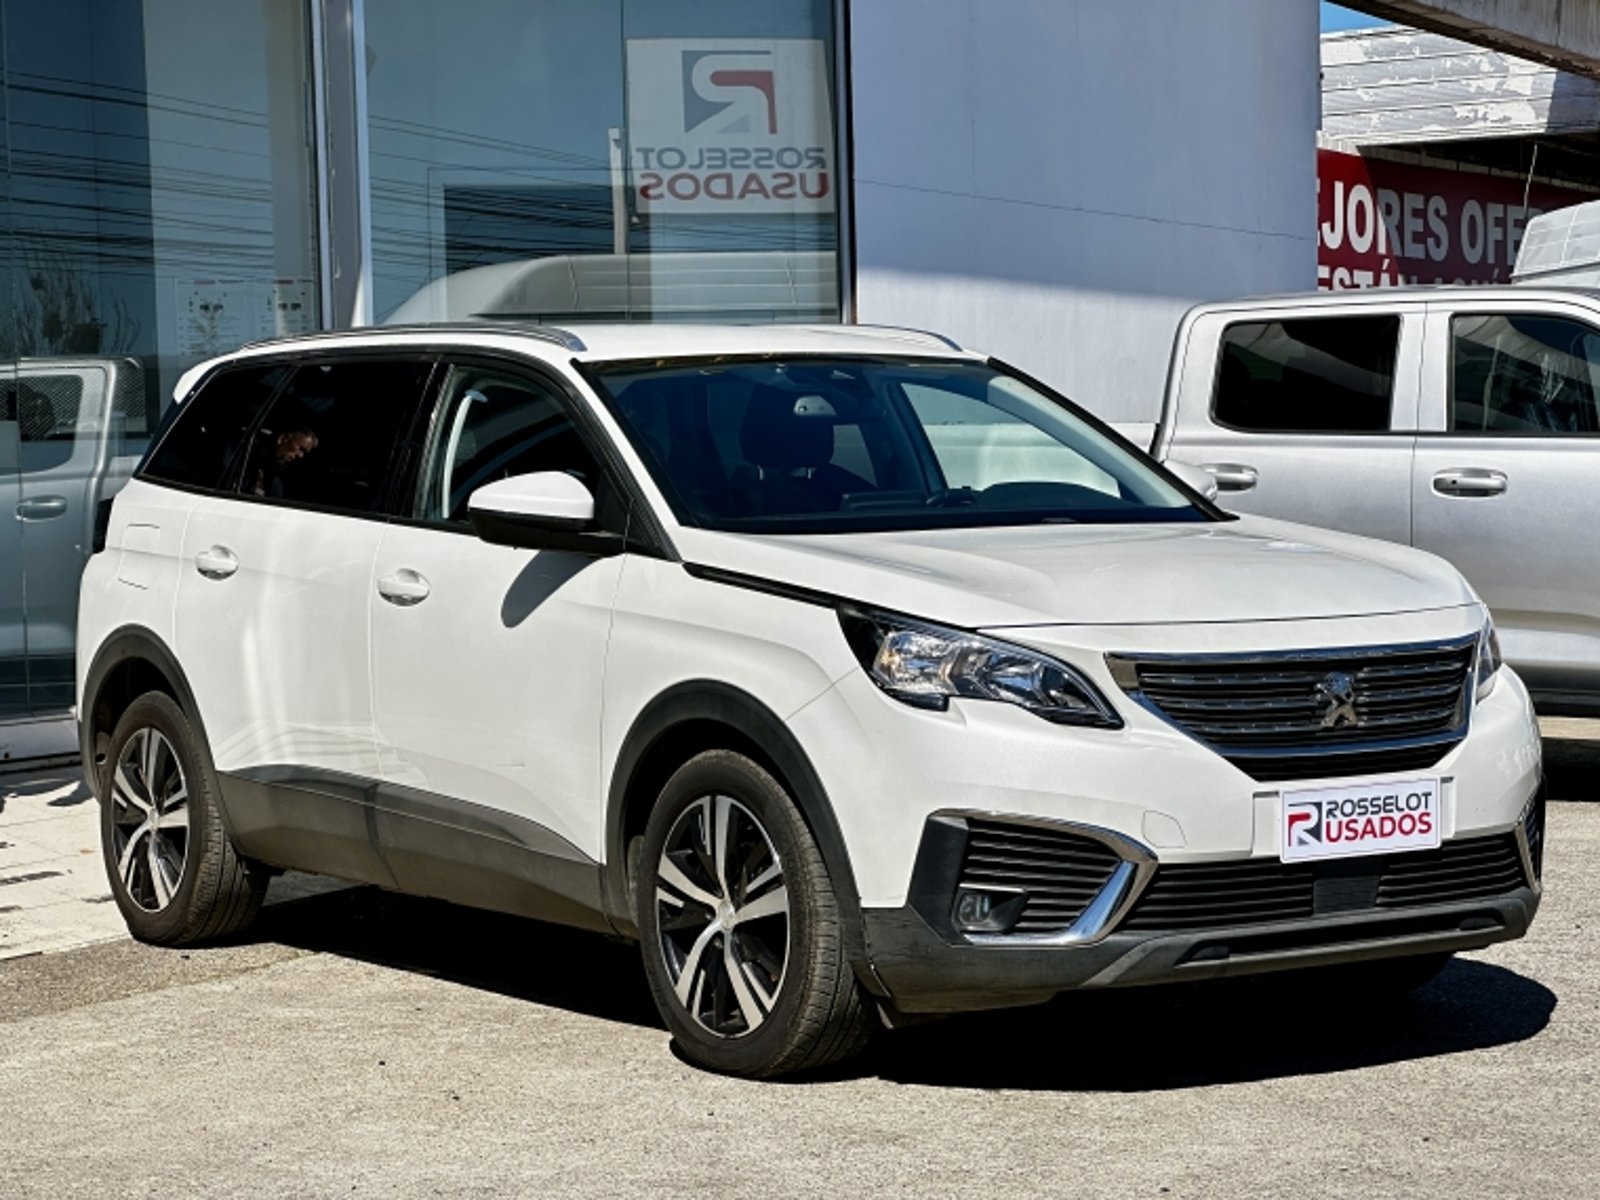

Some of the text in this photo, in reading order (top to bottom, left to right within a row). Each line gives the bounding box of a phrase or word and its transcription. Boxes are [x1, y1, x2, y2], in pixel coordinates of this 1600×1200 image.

[1317, 179, 1544, 267] JORES OFE
[1325, 792, 1432, 819] ROSSELOT
[1325, 812, 1432, 843] USADOS
